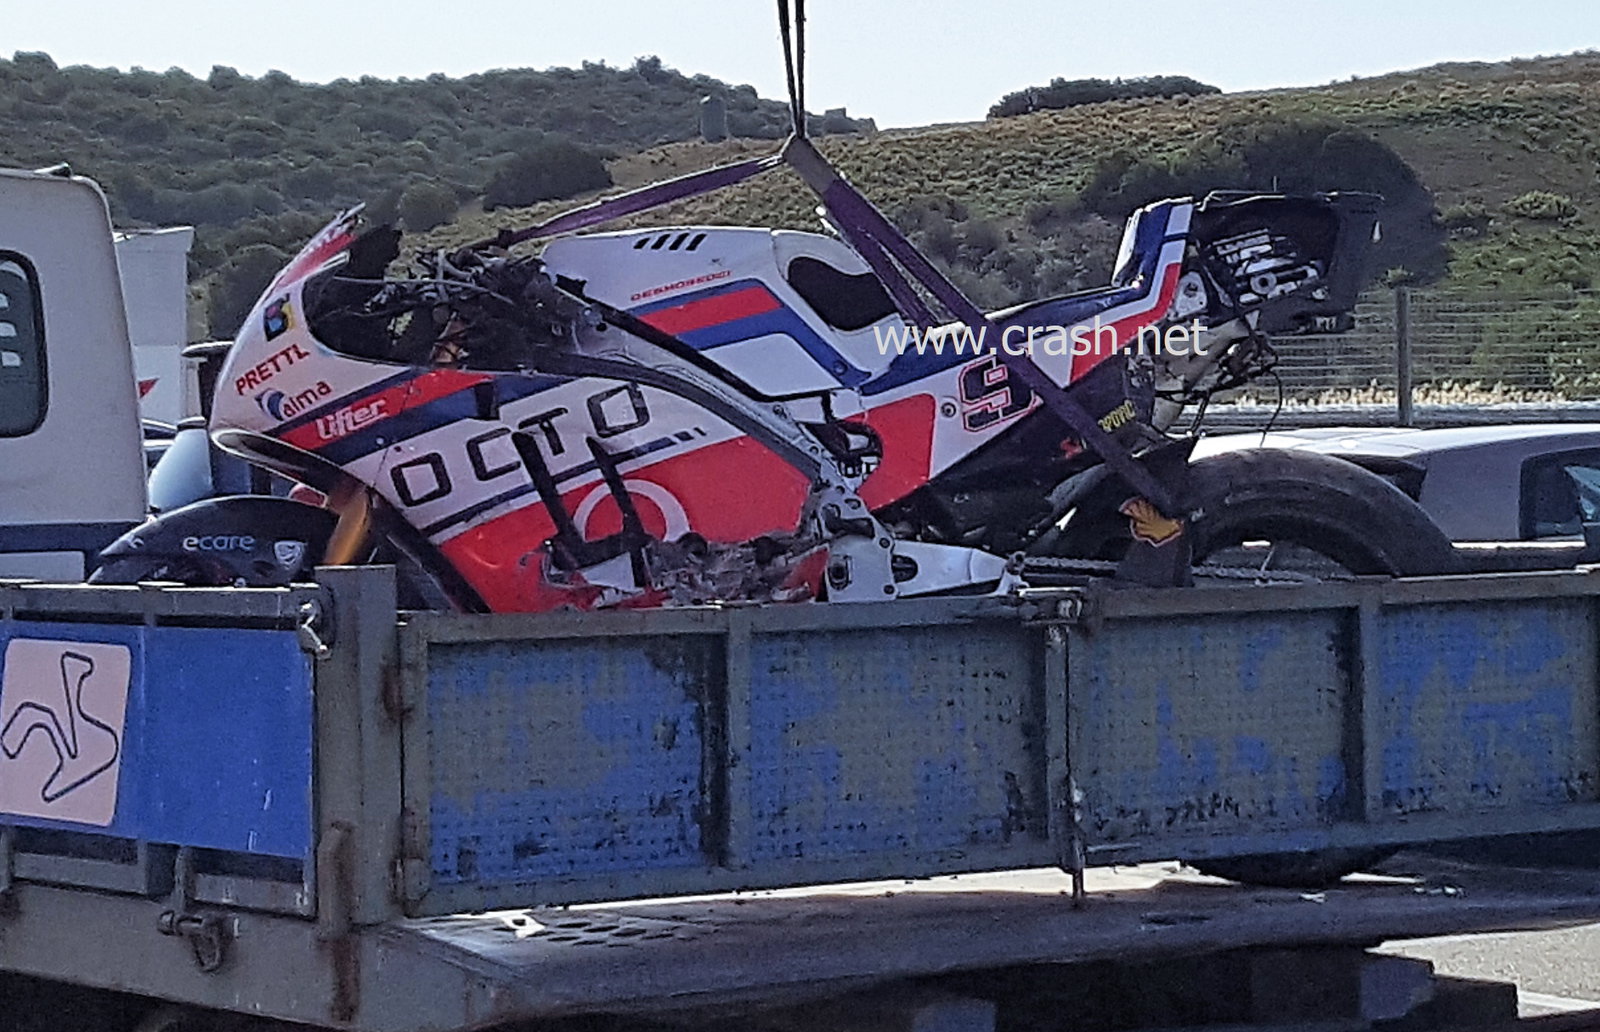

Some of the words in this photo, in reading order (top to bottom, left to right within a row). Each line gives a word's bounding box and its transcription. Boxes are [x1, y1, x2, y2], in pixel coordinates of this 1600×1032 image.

[235, 343, 311, 396] PRETTL
[389, 381, 650, 507] OCTO
[183, 535, 255, 552] ecare
